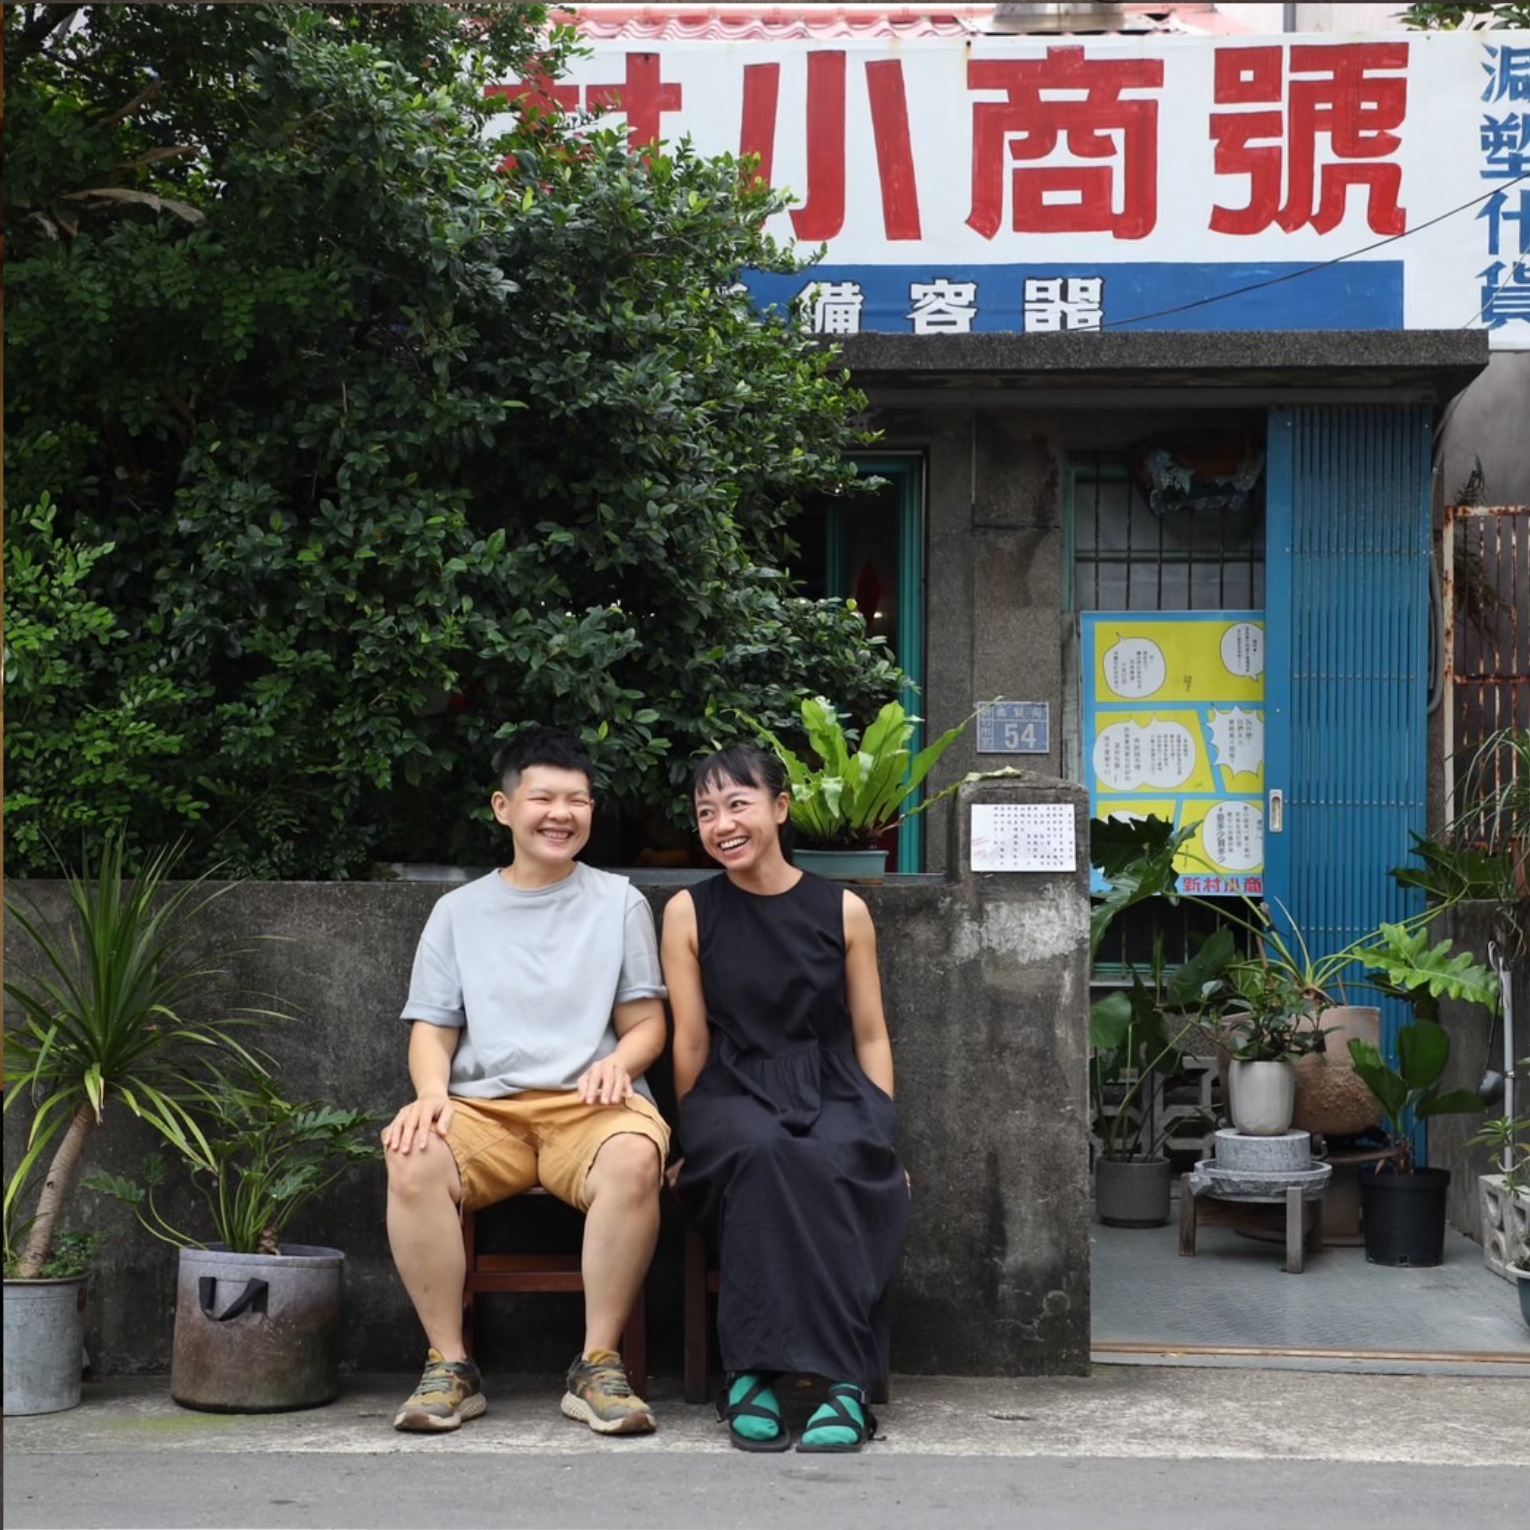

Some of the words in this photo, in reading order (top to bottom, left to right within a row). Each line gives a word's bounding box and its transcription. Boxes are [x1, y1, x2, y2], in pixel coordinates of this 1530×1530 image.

[716, 277, 1106, 335] 備容器
[1005, 723, 1037, 749] 54
